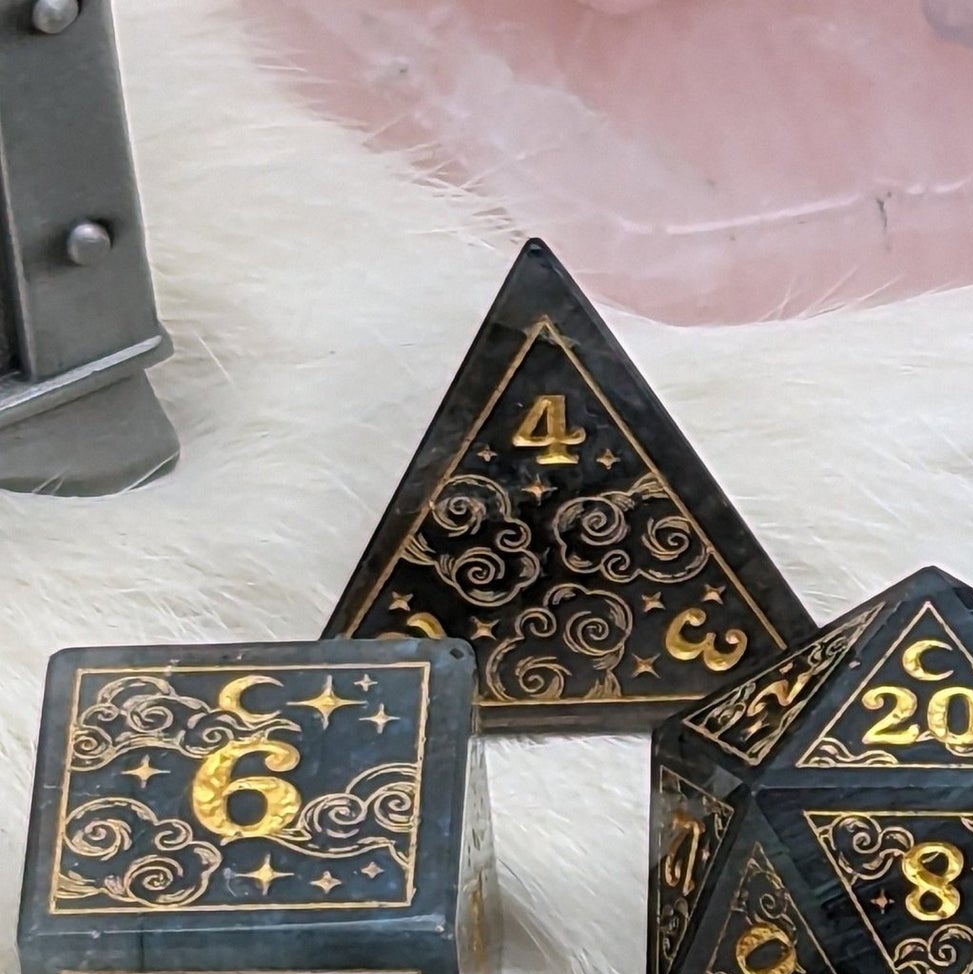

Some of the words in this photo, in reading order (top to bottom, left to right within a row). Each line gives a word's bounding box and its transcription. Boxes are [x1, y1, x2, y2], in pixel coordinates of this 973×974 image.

[512, 393, 586, 466] 4
[665, 607, 748, 671] 3
[746, 673, 813, 712] 2
[192, 739, 302, 839] 6
[902, 842, 965, 921] 8
